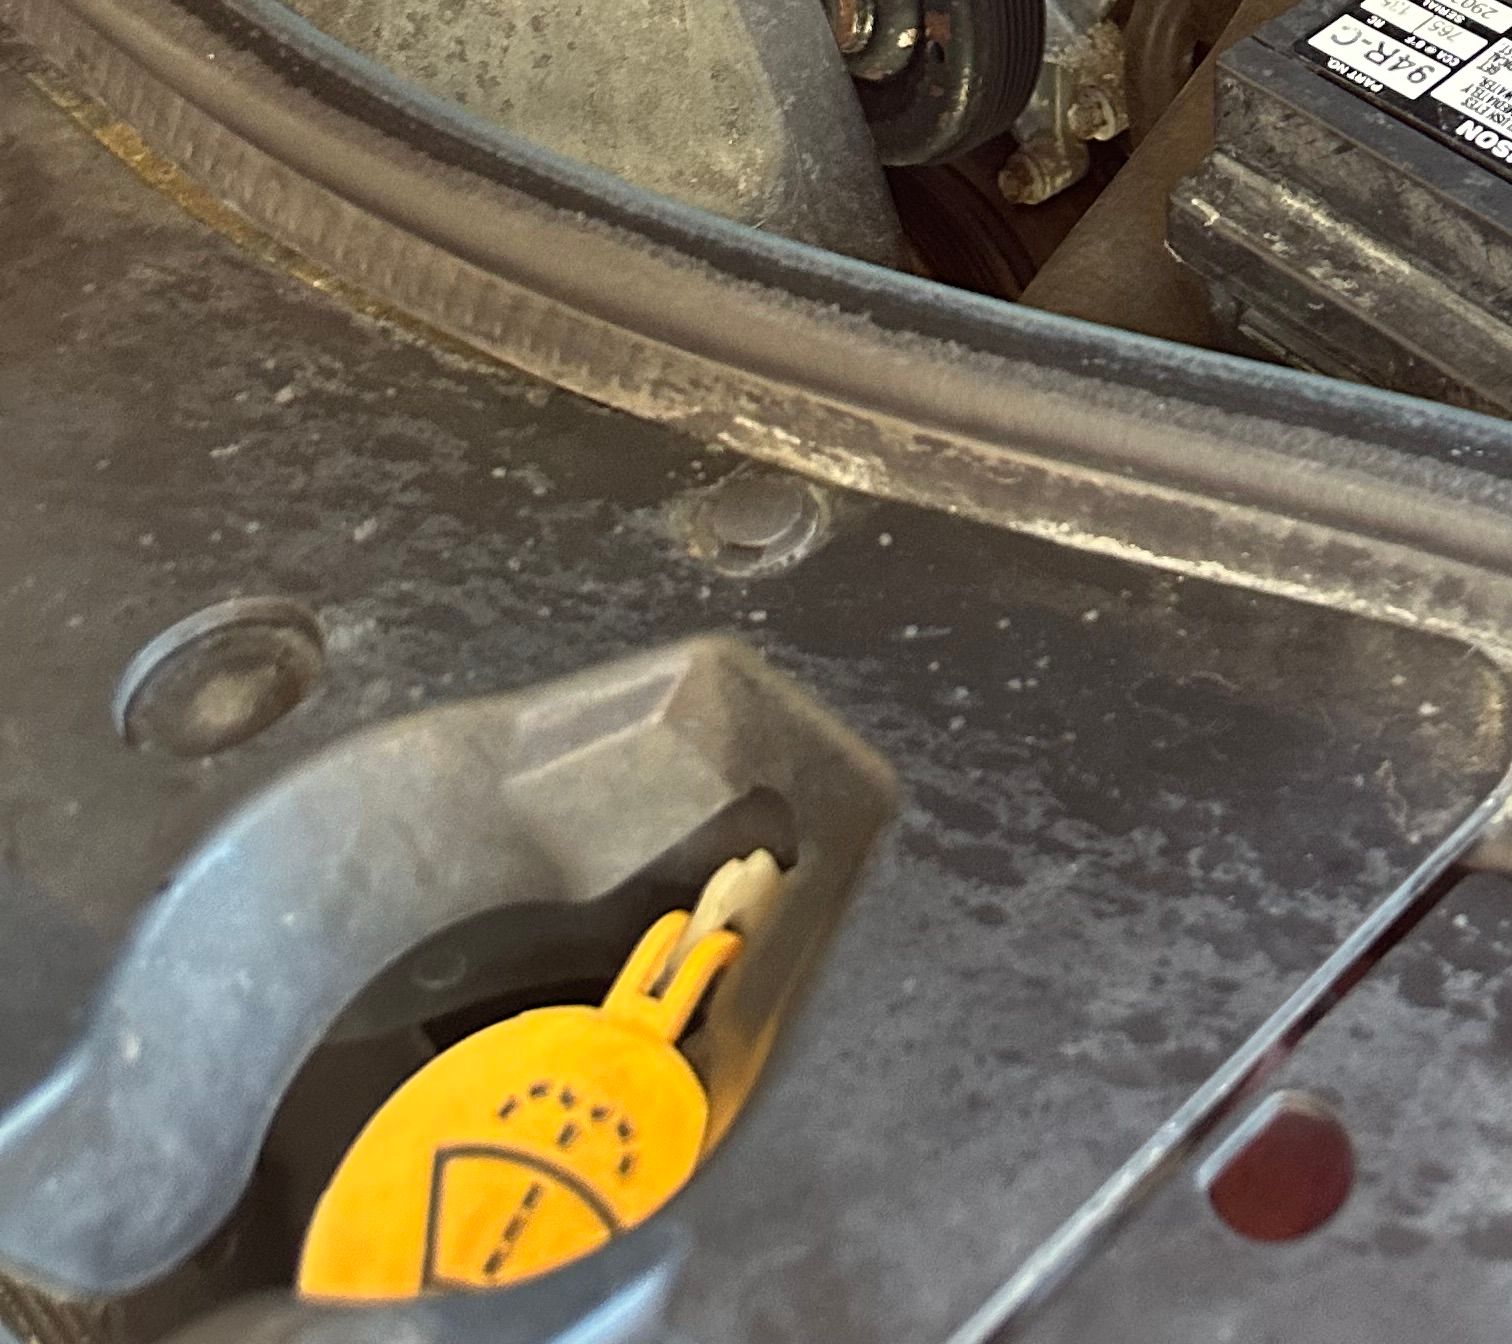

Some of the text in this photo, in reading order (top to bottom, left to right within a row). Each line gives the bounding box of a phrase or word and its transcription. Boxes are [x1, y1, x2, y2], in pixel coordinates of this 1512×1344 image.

[1363, 13, 1388, 29] RC
[1425, 18, 1465, 43] 765
[1325, 21, 1439, 86] 94R-C
[1432, 49, 1463, 67] CCA
[1475, 59, 1501, 76] GET
[1343, 68, 1386, 93] PART
[1458, 95, 1492, 116] EYES
